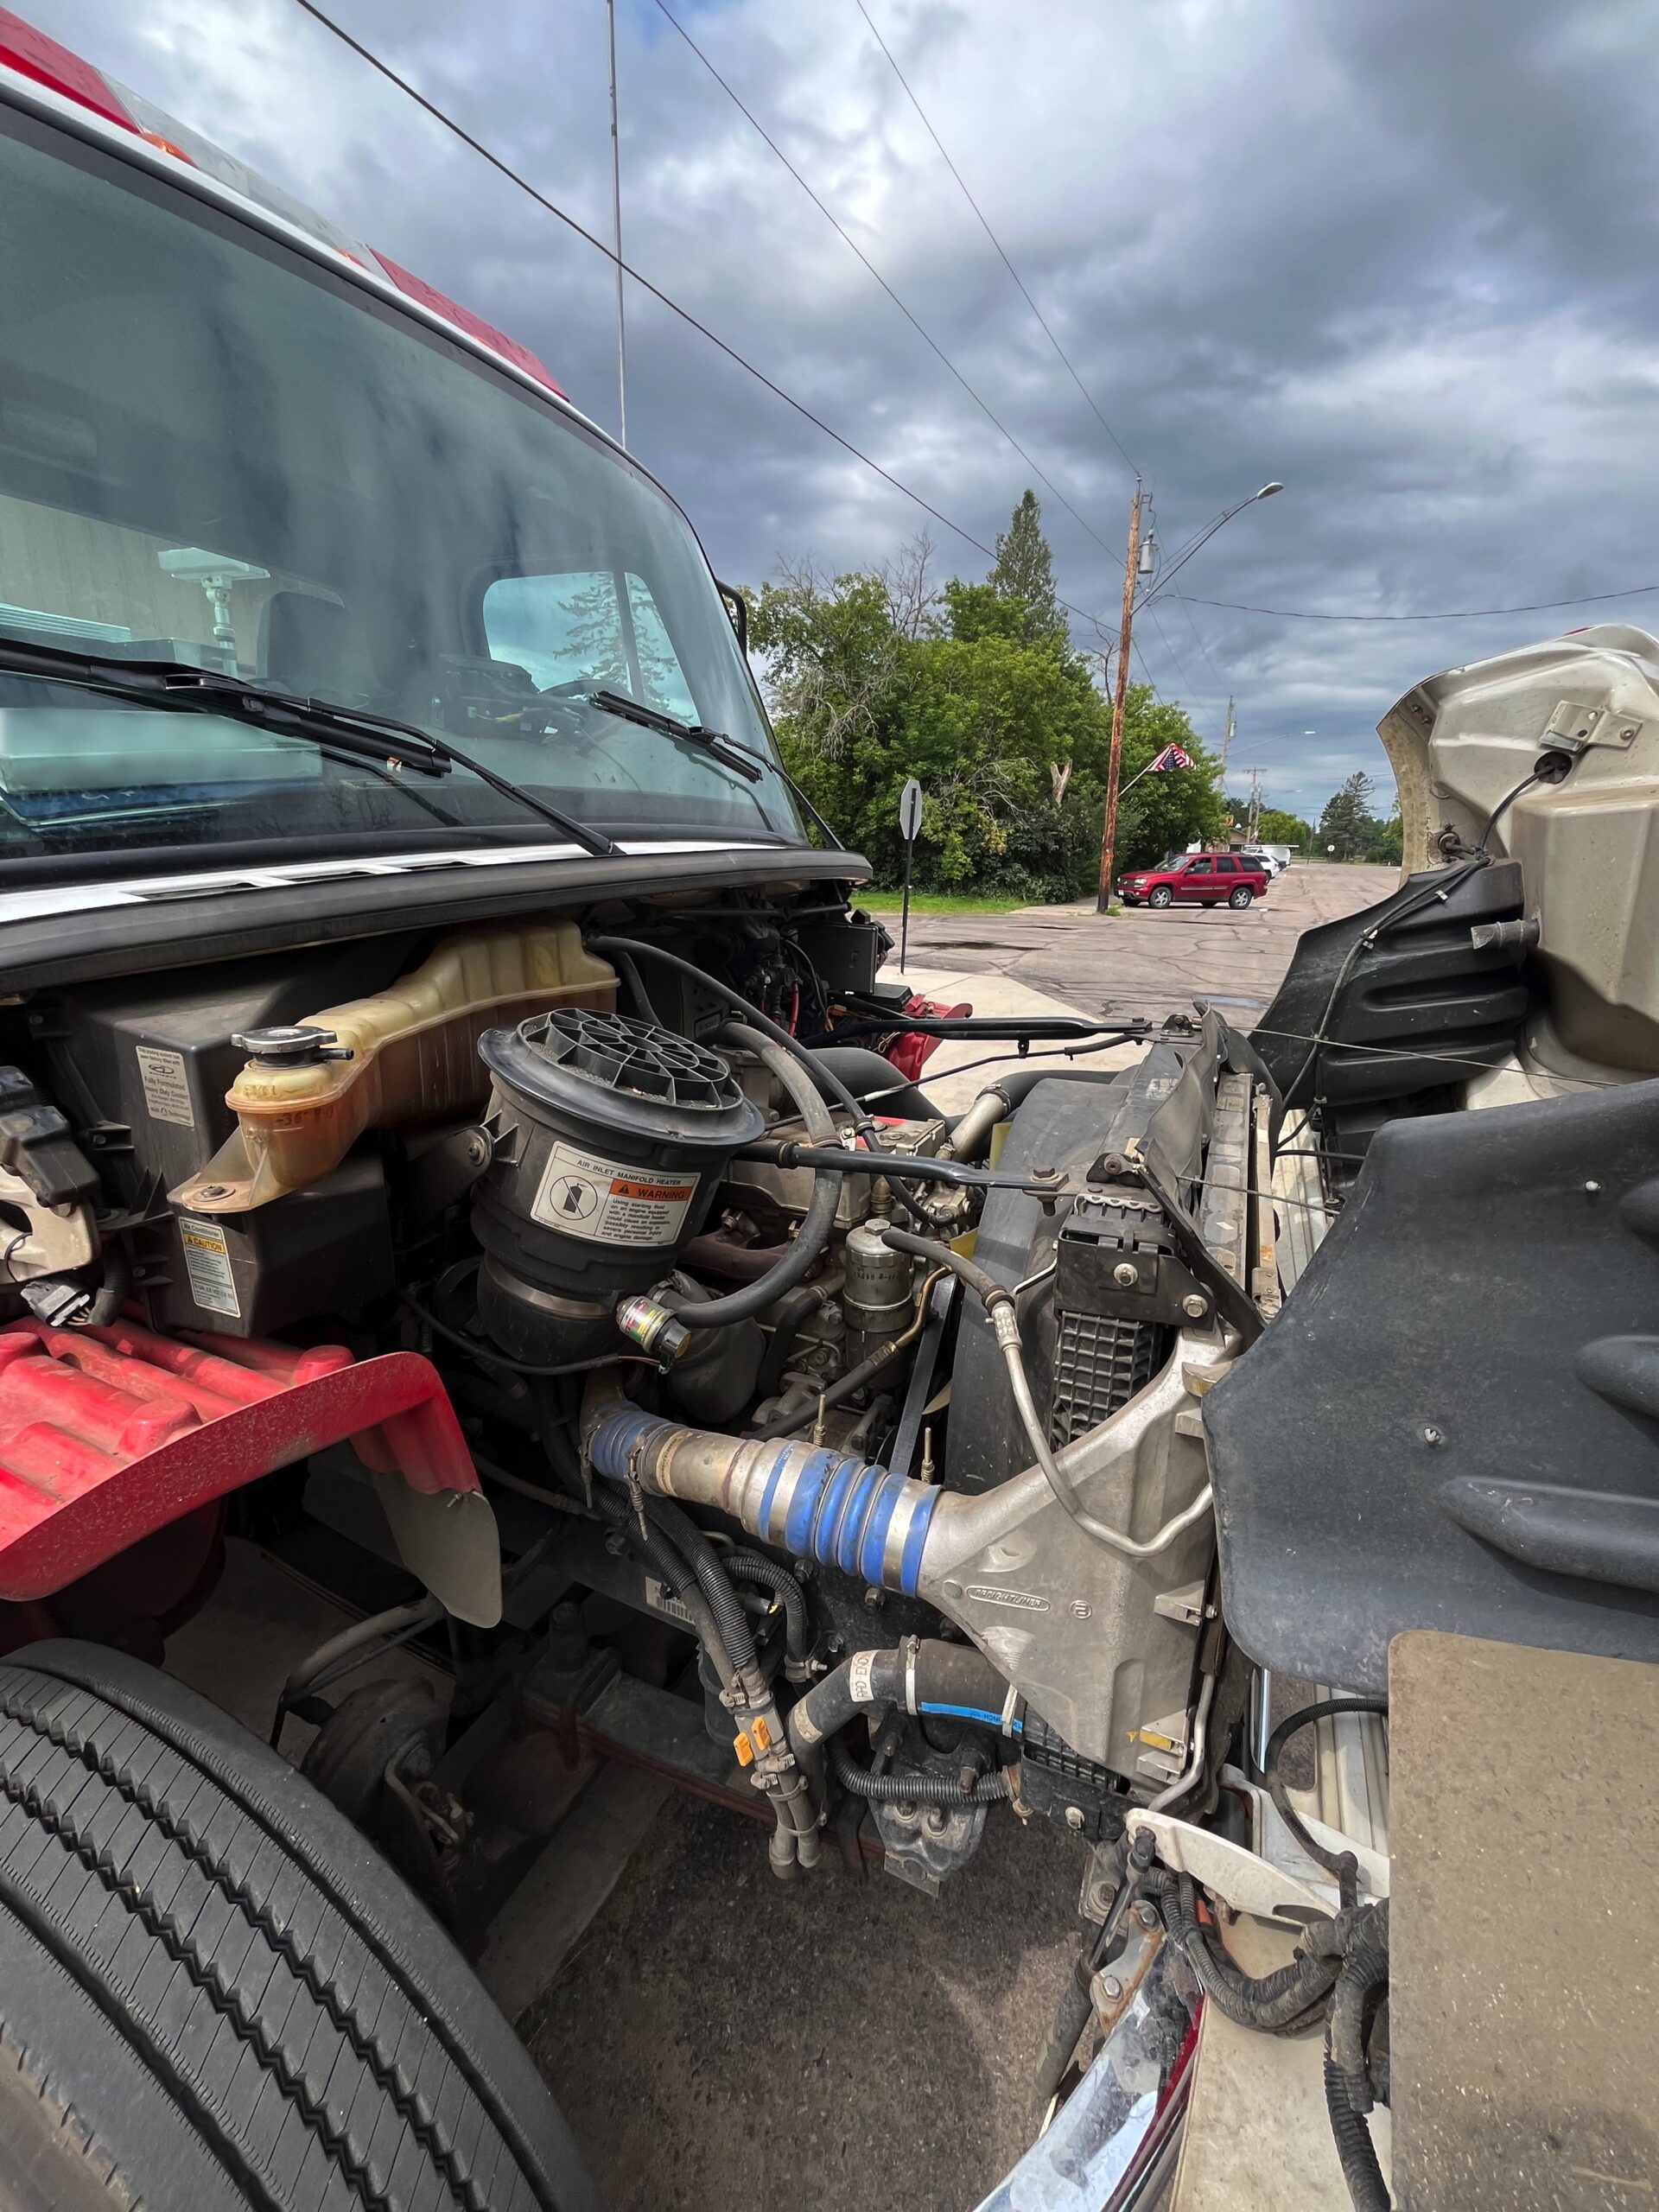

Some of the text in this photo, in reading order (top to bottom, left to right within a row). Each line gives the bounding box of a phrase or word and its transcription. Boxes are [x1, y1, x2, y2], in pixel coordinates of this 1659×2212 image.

[577, 1159, 590, 1169] AIR
[593, 1165, 614, 1176] INLET
[617, 1172, 654, 1184] MANIFOLD
[638, 1188, 685, 1199] WARNING
[605, 1220, 628, 1229] possibly
[194, 1237, 222, 1251] CAUTION
[855, 1657, 869, 1675] END
